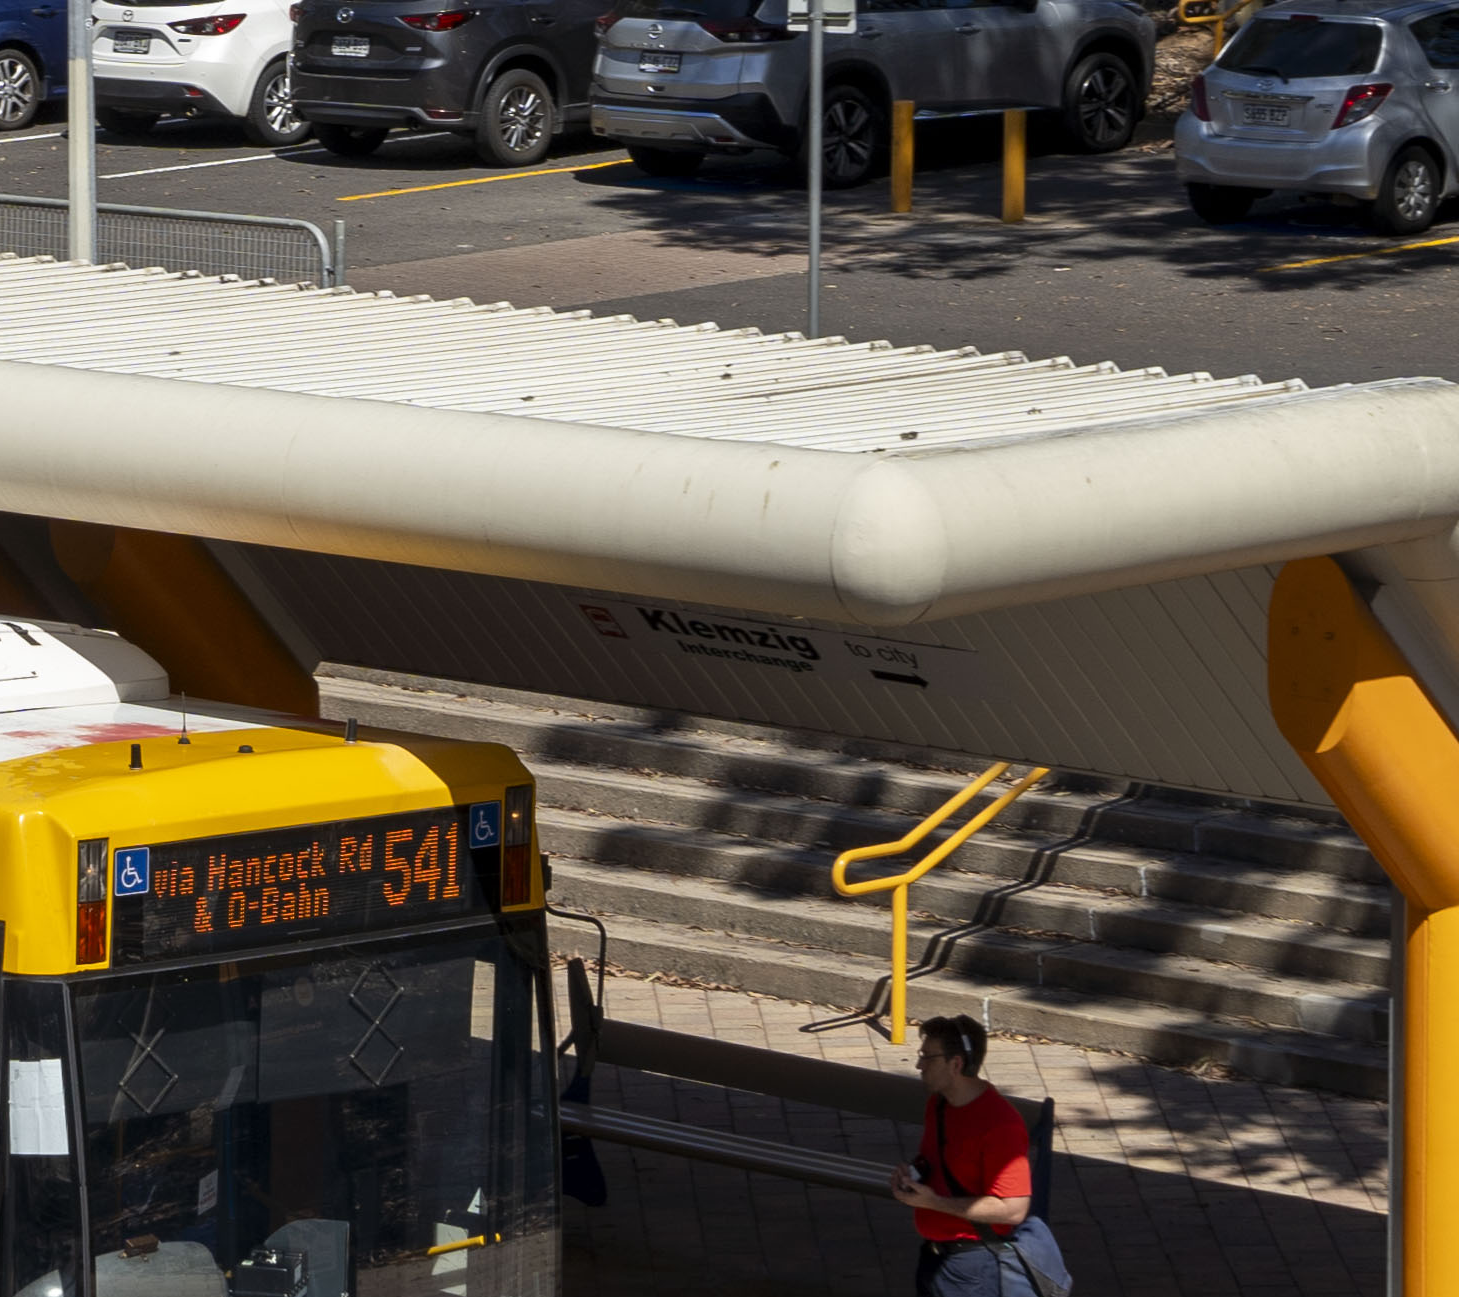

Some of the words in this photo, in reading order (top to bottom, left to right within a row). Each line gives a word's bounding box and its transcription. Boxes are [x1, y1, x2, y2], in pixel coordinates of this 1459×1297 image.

[634, 606, 822, 661] Klemzig
[844, 640, 871, 659] to
[882, 645, 919, 668] city
[677, 640, 815, 672] Interchange
[154, 861, 194, 899] via
[207, 841, 326, 892] Hancock
[339, 834, 373, 873] Rd
[383, 822, 460, 906] 541
[194, 896, 213, 933] &
[228, 882, 330, 929] O-Bahn
